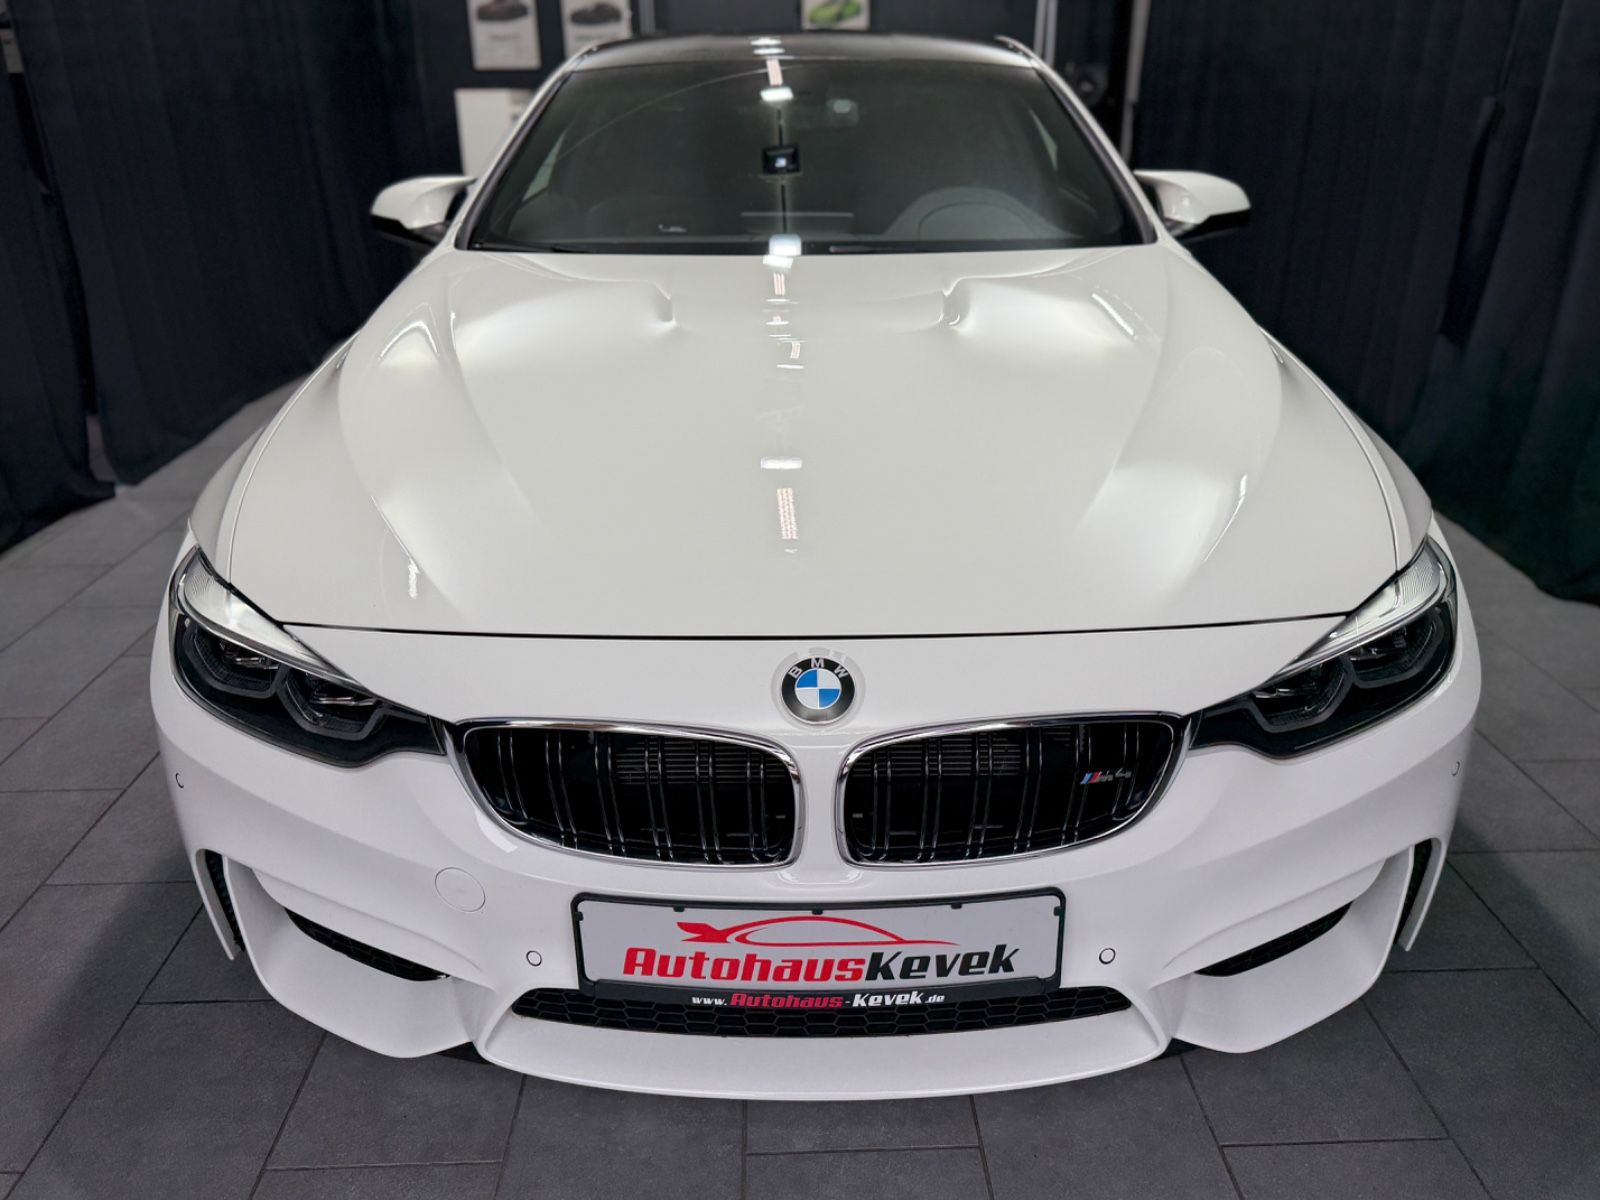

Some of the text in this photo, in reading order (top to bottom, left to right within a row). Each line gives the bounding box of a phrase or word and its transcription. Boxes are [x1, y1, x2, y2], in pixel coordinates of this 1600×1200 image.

[788, 657, 849, 679] BMW
[622, 944, 1020, 983] AutohausKevek
[691, 990, 945, 1009] www.Autohaus-Kevek.de
